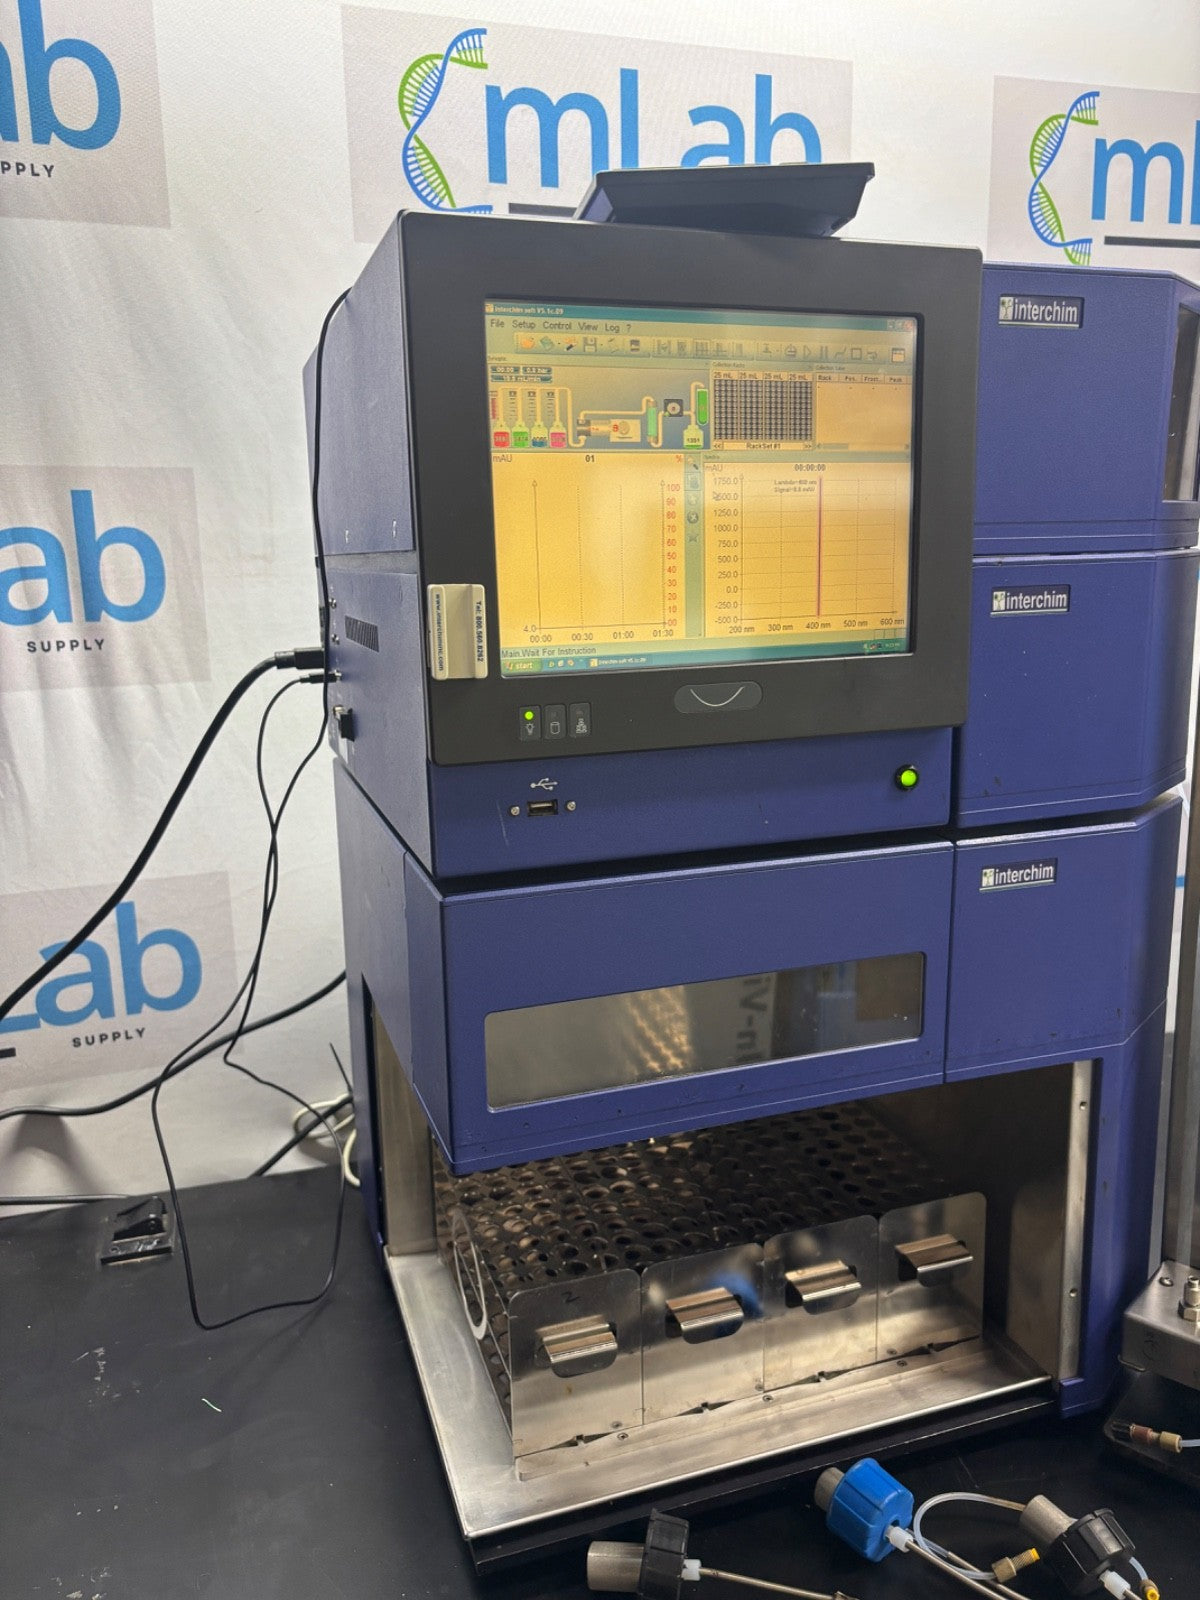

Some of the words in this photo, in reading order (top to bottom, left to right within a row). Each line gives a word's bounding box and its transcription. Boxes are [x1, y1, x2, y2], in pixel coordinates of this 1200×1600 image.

[0, 0, 122, 150] b
[1014, 298, 1078, 322] interchim
[490, 319, 505, 328] File
[512, 320, 536, 330] Setup
[542, 321, 573, 331] Control
[578, 322, 599, 331] View
[605, 323, 620, 334] Log
[493, 455, 513, 463] mAU
[585, 455, 595, 463] 01
[713, 477, 739, 486] 1750.0
[667, 484, 681, 492] 100
[666, 498, 676, 506] 90
[666, 511, 676, 519] 80
[713, 508, 739, 517] 1250.0
[666, 525, 677, 533] 70
[713, 523, 739, 533] 1000.0
[666, 539, 677, 547] 60
[718, 539, 739, 548] 750.0
[666, 552, 677, 560] 50
[717, 555, 739, 564] 500.0
[666, 566, 677, 574] 40
[717, 570, 739, 579] 250.0
[667, 579, 677, 588] 30
[726, 585, 739, 594] 0.0
[667, 593, 677, 601] 20
[1006, 590, 1068, 610] interchim
[475, 600, 483, 613] Tel:
[714, 601, 739, 609] -250.0
[714, 616, 738, 624] -500.0
[843, 620, 857, 628] 500
[880, 618, 894, 626] 600
[728, 626, 743, 634] 200
[767, 624, 781, 632] 300
[571, 633, 594, 642] 00:30
[612, 631, 635, 640] 01:00
[652, 629, 674, 638] 01:30
[529, 635, 553, 644] 00:00
[27, 639, 105, 653] SUPPLY
[542, 647, 555, 656] For
[557, 646, 597, 656] Instruction
[515, 661, 533, 670] start
[995, 863, 1054, 885] interchim
[72, 1027, 146, 1048] SUPPLY
